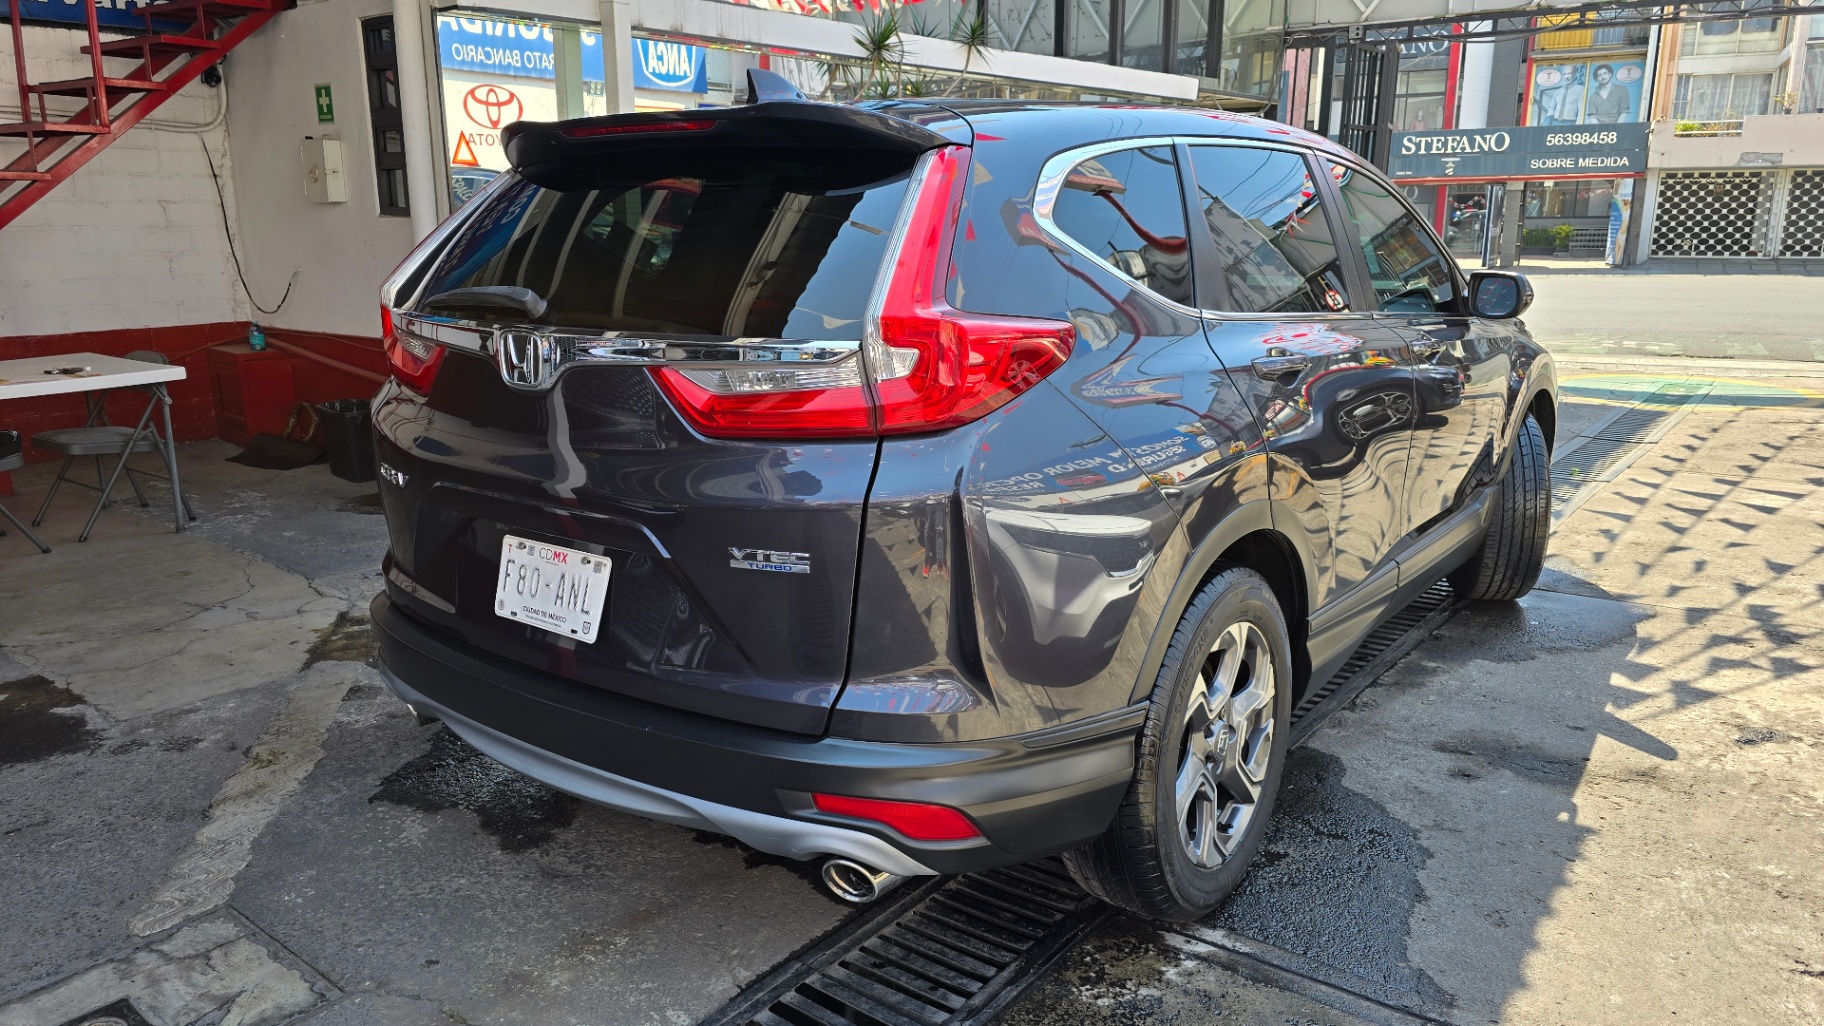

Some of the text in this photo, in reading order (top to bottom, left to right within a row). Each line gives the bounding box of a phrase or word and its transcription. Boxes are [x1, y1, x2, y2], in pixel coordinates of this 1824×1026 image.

[1401, 131, 1511, 155] STEFANO
[1546, 131, 1617, 146] 56398458
[1530, 156, 1629, 169] SOBRE MEDIDA
[539, 547, 569, 564] CDMX
[728, 547, 810, 565] VTEC
[746, 561, 792, 571] TURBO
[522, 605, 540, 616] CIUDAD
[541, 610, 548, 619] DE
[548, 612, 567, 624] MÉXICO
